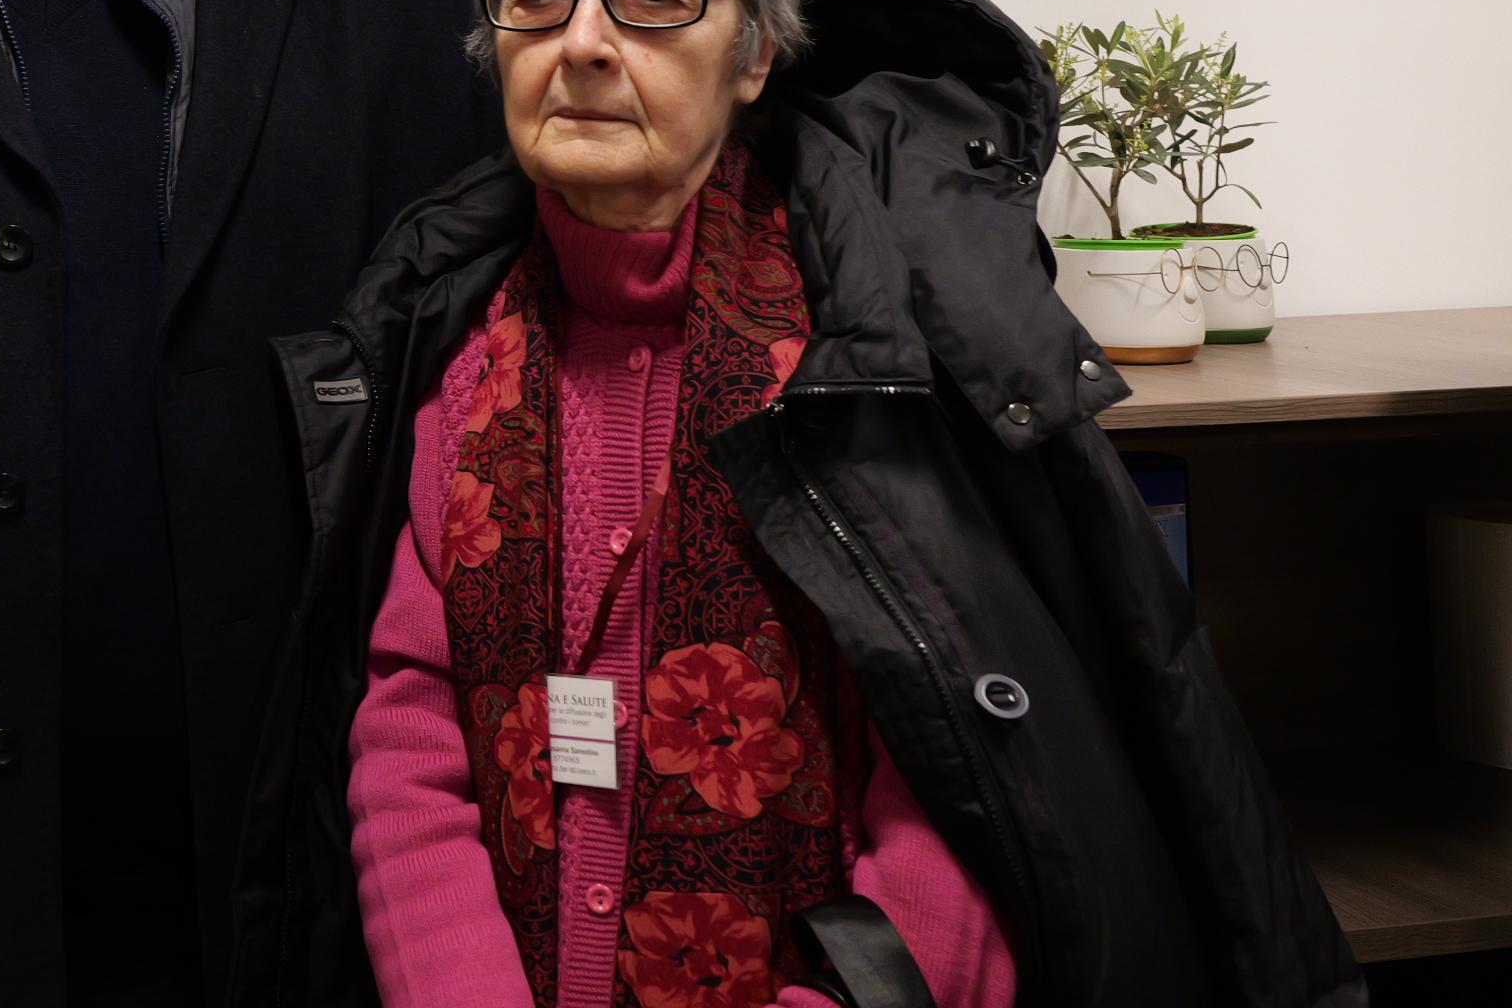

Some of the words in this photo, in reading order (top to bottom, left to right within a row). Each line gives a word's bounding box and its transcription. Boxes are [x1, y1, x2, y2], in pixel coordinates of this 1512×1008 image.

[317, 385, 361, 396] GEOX
[564, 695, 568, 704] E
[572, 695, 607, 708] SALUTE
